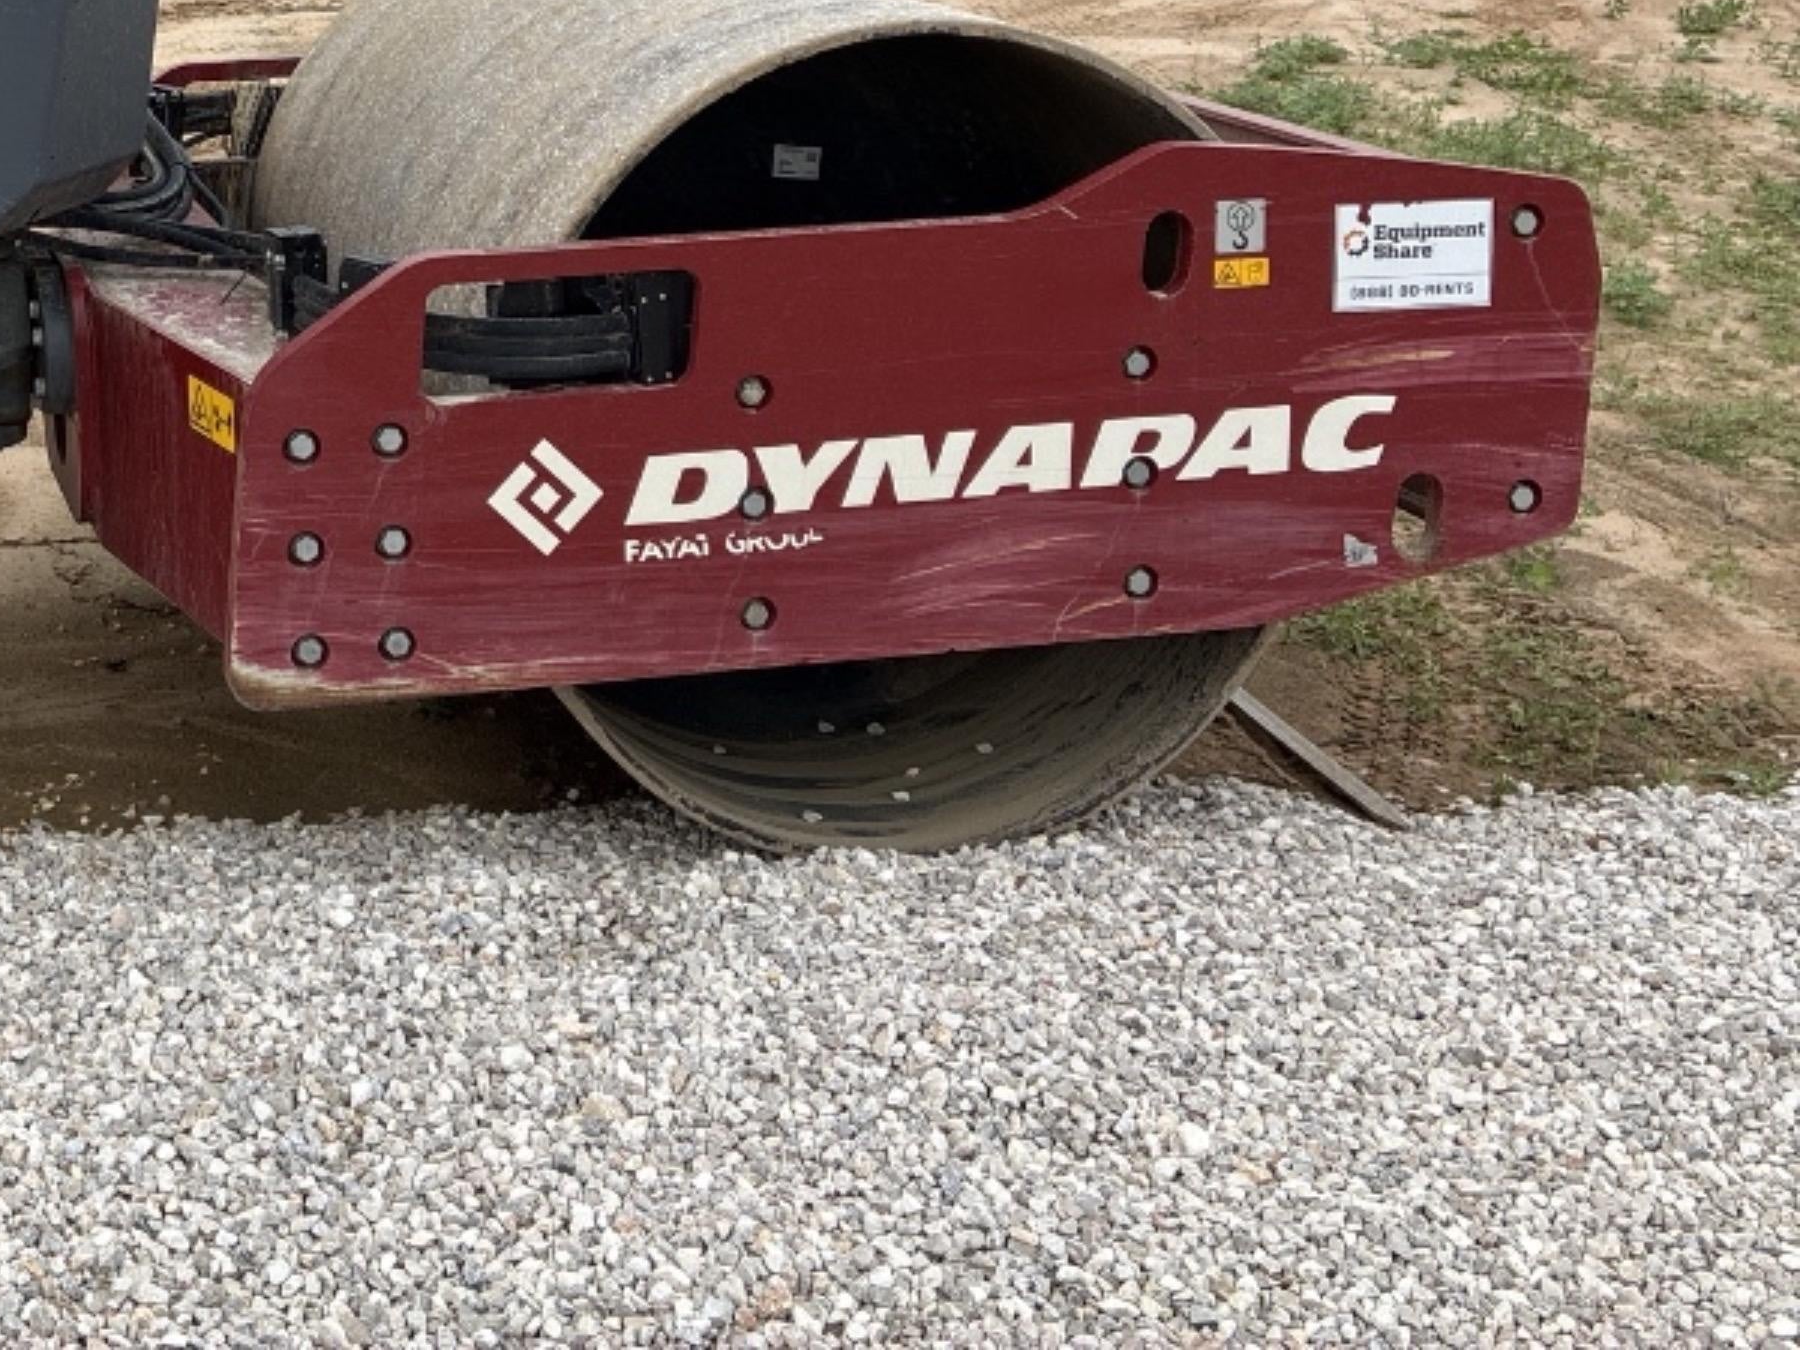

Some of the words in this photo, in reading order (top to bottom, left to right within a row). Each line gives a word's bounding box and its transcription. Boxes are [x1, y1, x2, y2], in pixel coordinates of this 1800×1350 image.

[1372, 221, 1486, 243] Equipment
[1372, 243, 1433, 260] Share
[623, 394, 1398, 526] DYNAPAC
